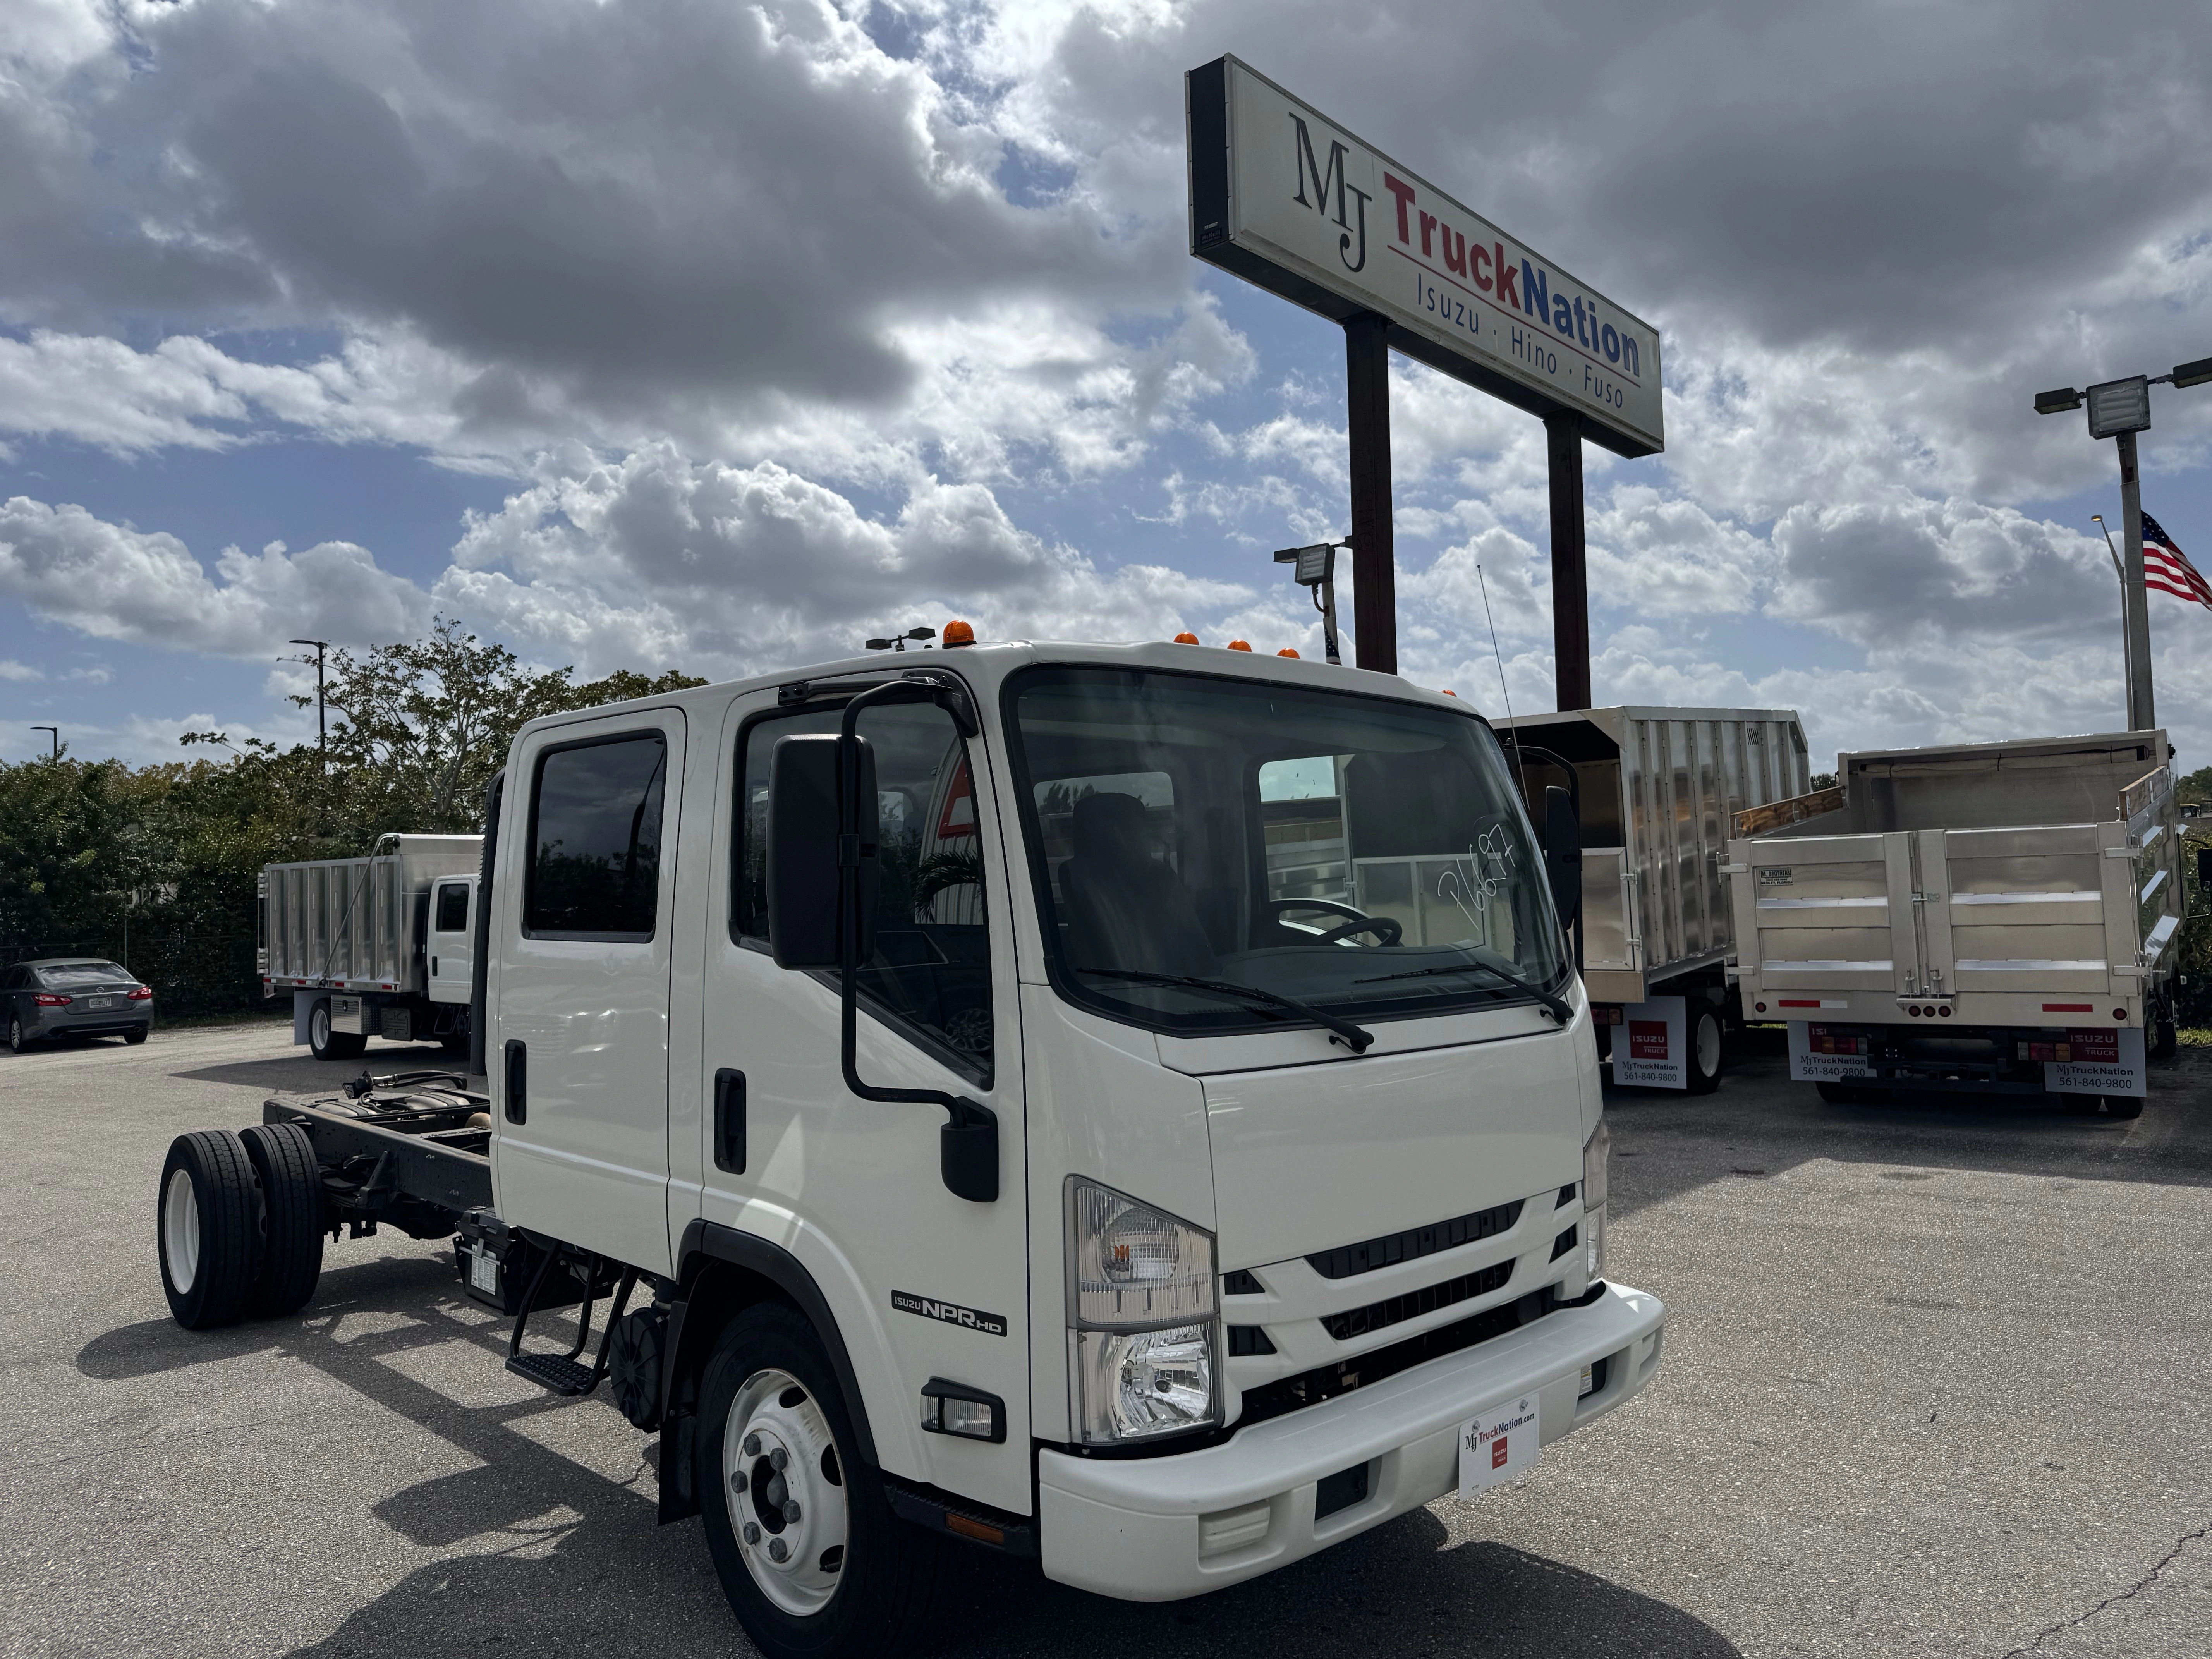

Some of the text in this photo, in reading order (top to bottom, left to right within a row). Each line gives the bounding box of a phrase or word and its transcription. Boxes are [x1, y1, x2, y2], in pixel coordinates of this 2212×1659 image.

[1288, 111, 1640, 377] MJ TruckNation
[1418, 273, 1623, 409] Isuzu Hino Fuso
[1632, 1035, 1665, 1043] ISUZU
[2070, 1034, 2114, 1043] ISUZU
[1812, 1057, 1866, 1065] TruckNation
[1633, 1063, 1678, 1071] TruckNation
[1803, 1066, 1865, 1077] 561-840-9800
[2070, 1066, 2133, 1076] TruckNation
[1624, 1072, 1677, 1082] 561-840-9800
[2059, 1077, 2132, 1089] 561-840-9800
[895, 1296, 921, 1310] ISUZU
[1465, 1413, 1534, 1452] MJ TruckNation.com
[1493, 1448, 1506, 1457] ISUZU
